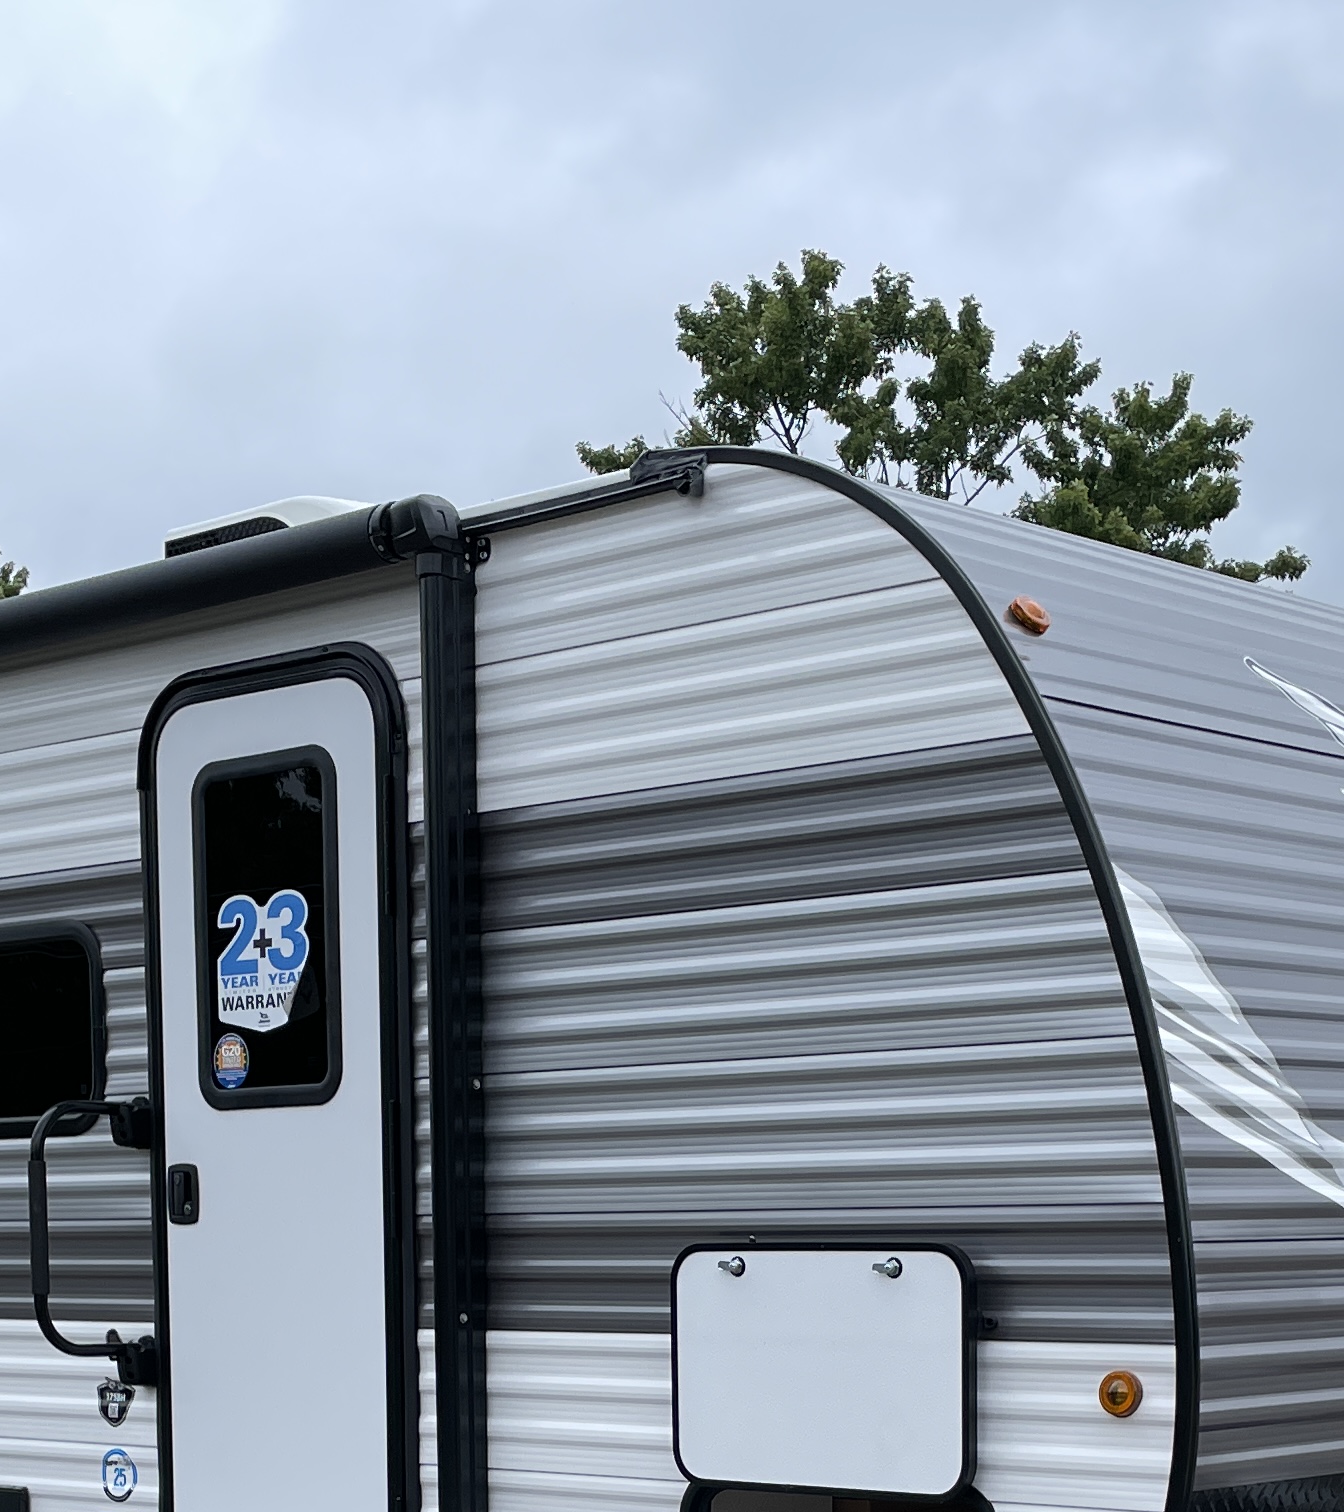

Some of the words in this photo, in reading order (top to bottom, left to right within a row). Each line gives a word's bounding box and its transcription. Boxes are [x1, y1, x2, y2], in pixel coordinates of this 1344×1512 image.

[221, 975, 259, 989] YEAR
[221, 992, 292, 1011] WARRAN
[221, 1045, 241, 1057] G20
[113, 1467, 127, 1487] 25
